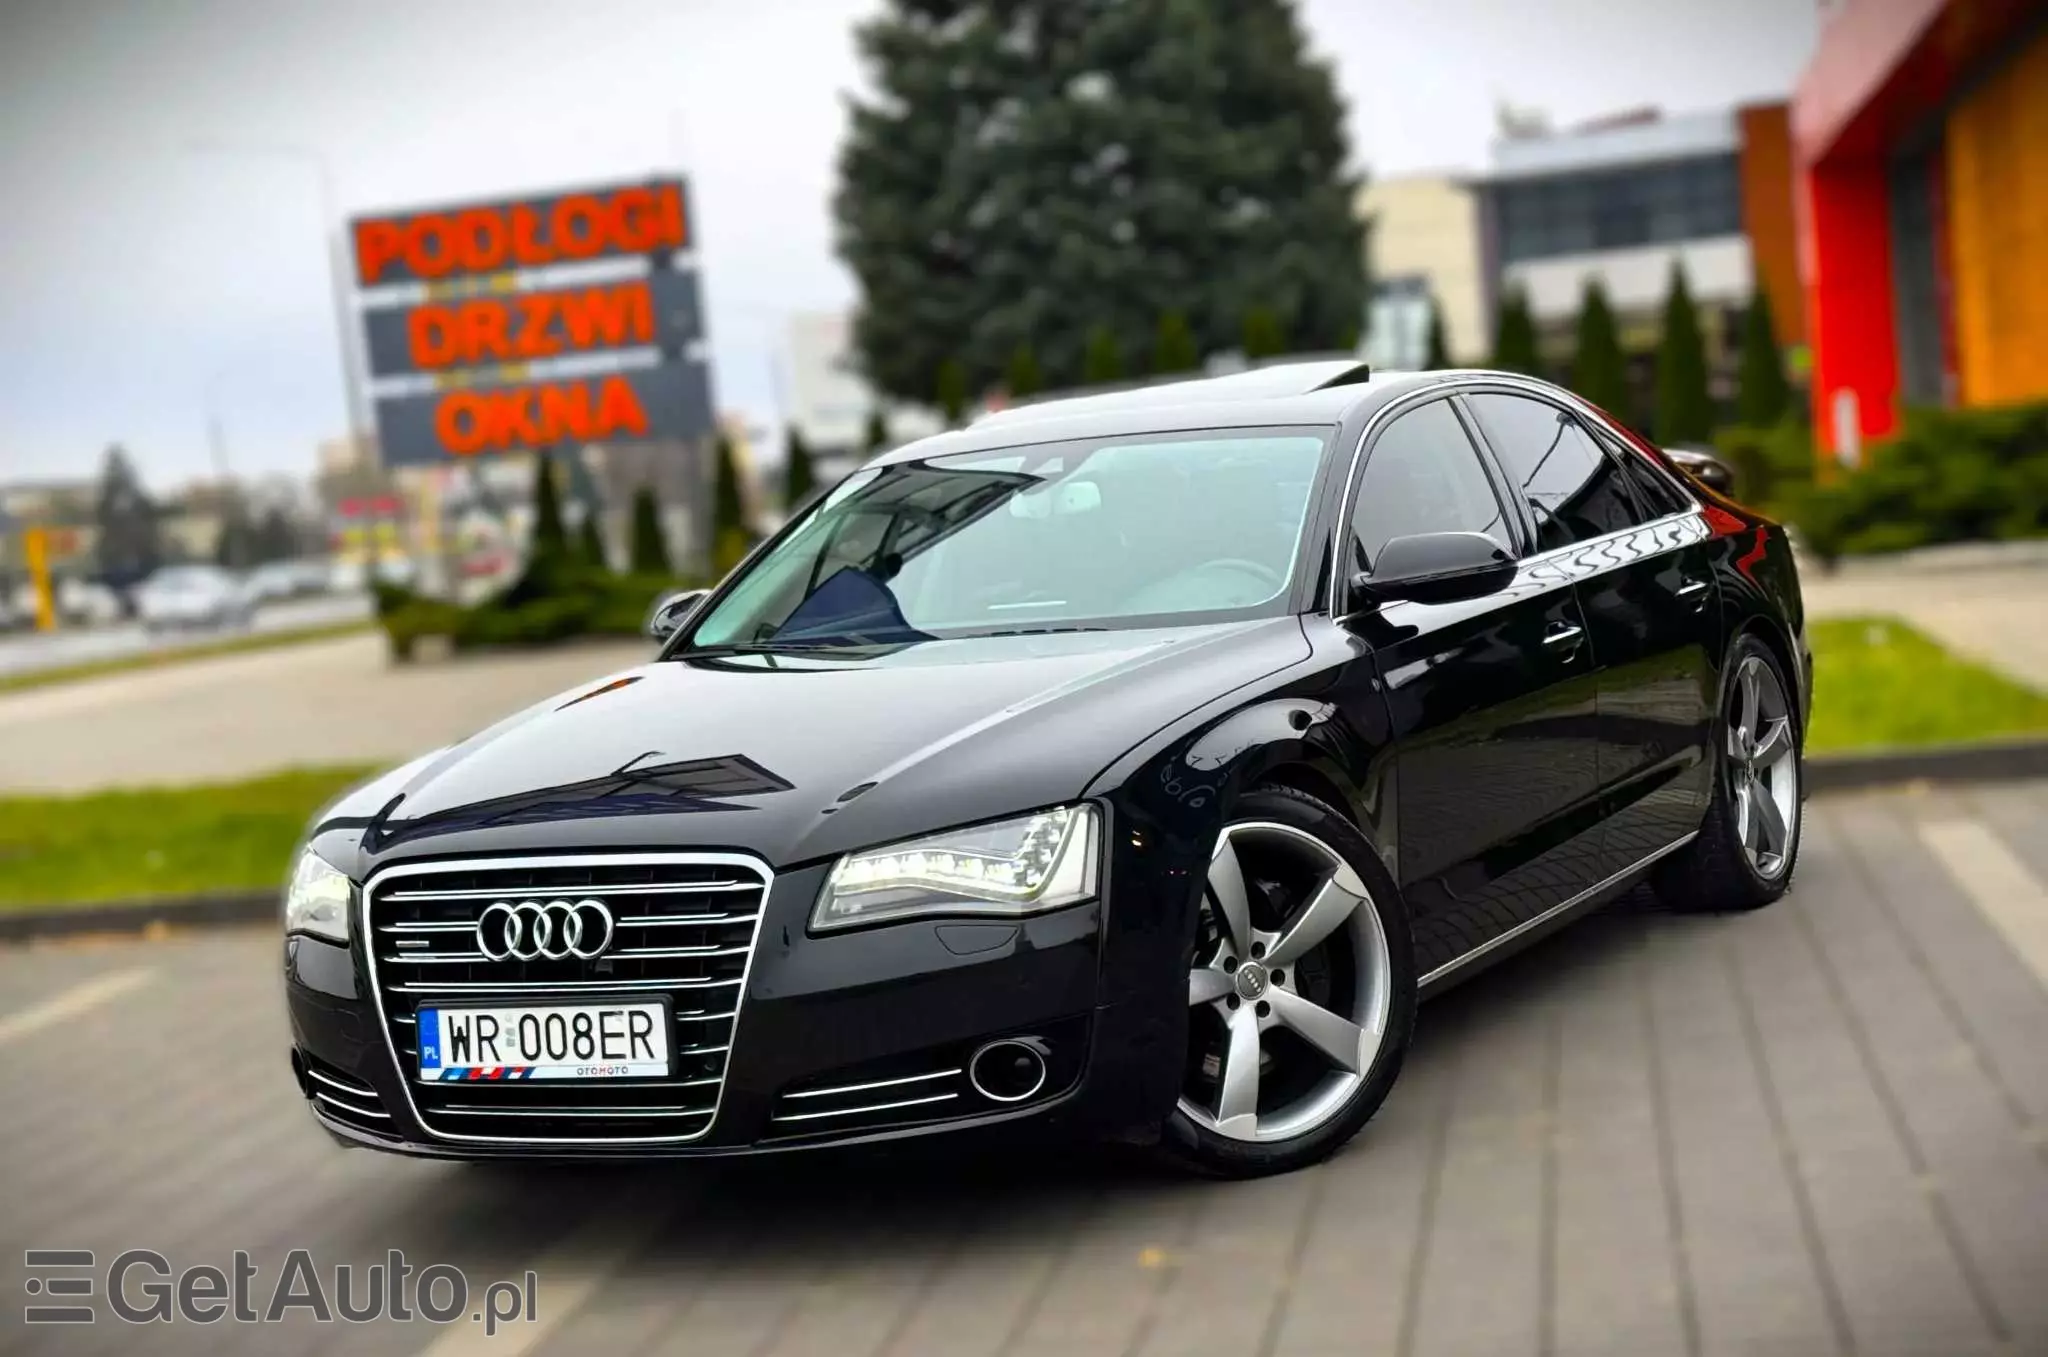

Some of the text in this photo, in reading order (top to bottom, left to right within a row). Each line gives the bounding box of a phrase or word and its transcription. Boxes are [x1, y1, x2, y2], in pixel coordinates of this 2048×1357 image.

[407, 281, 656, 369] DRZWI
[434, 376, 649, 455] OKNA
[424, 1046, 438, 1058] PL
[448, 1010, 655, 1062] WR 008ER
[576, 1066, 629, 1076] OTOMOTO
